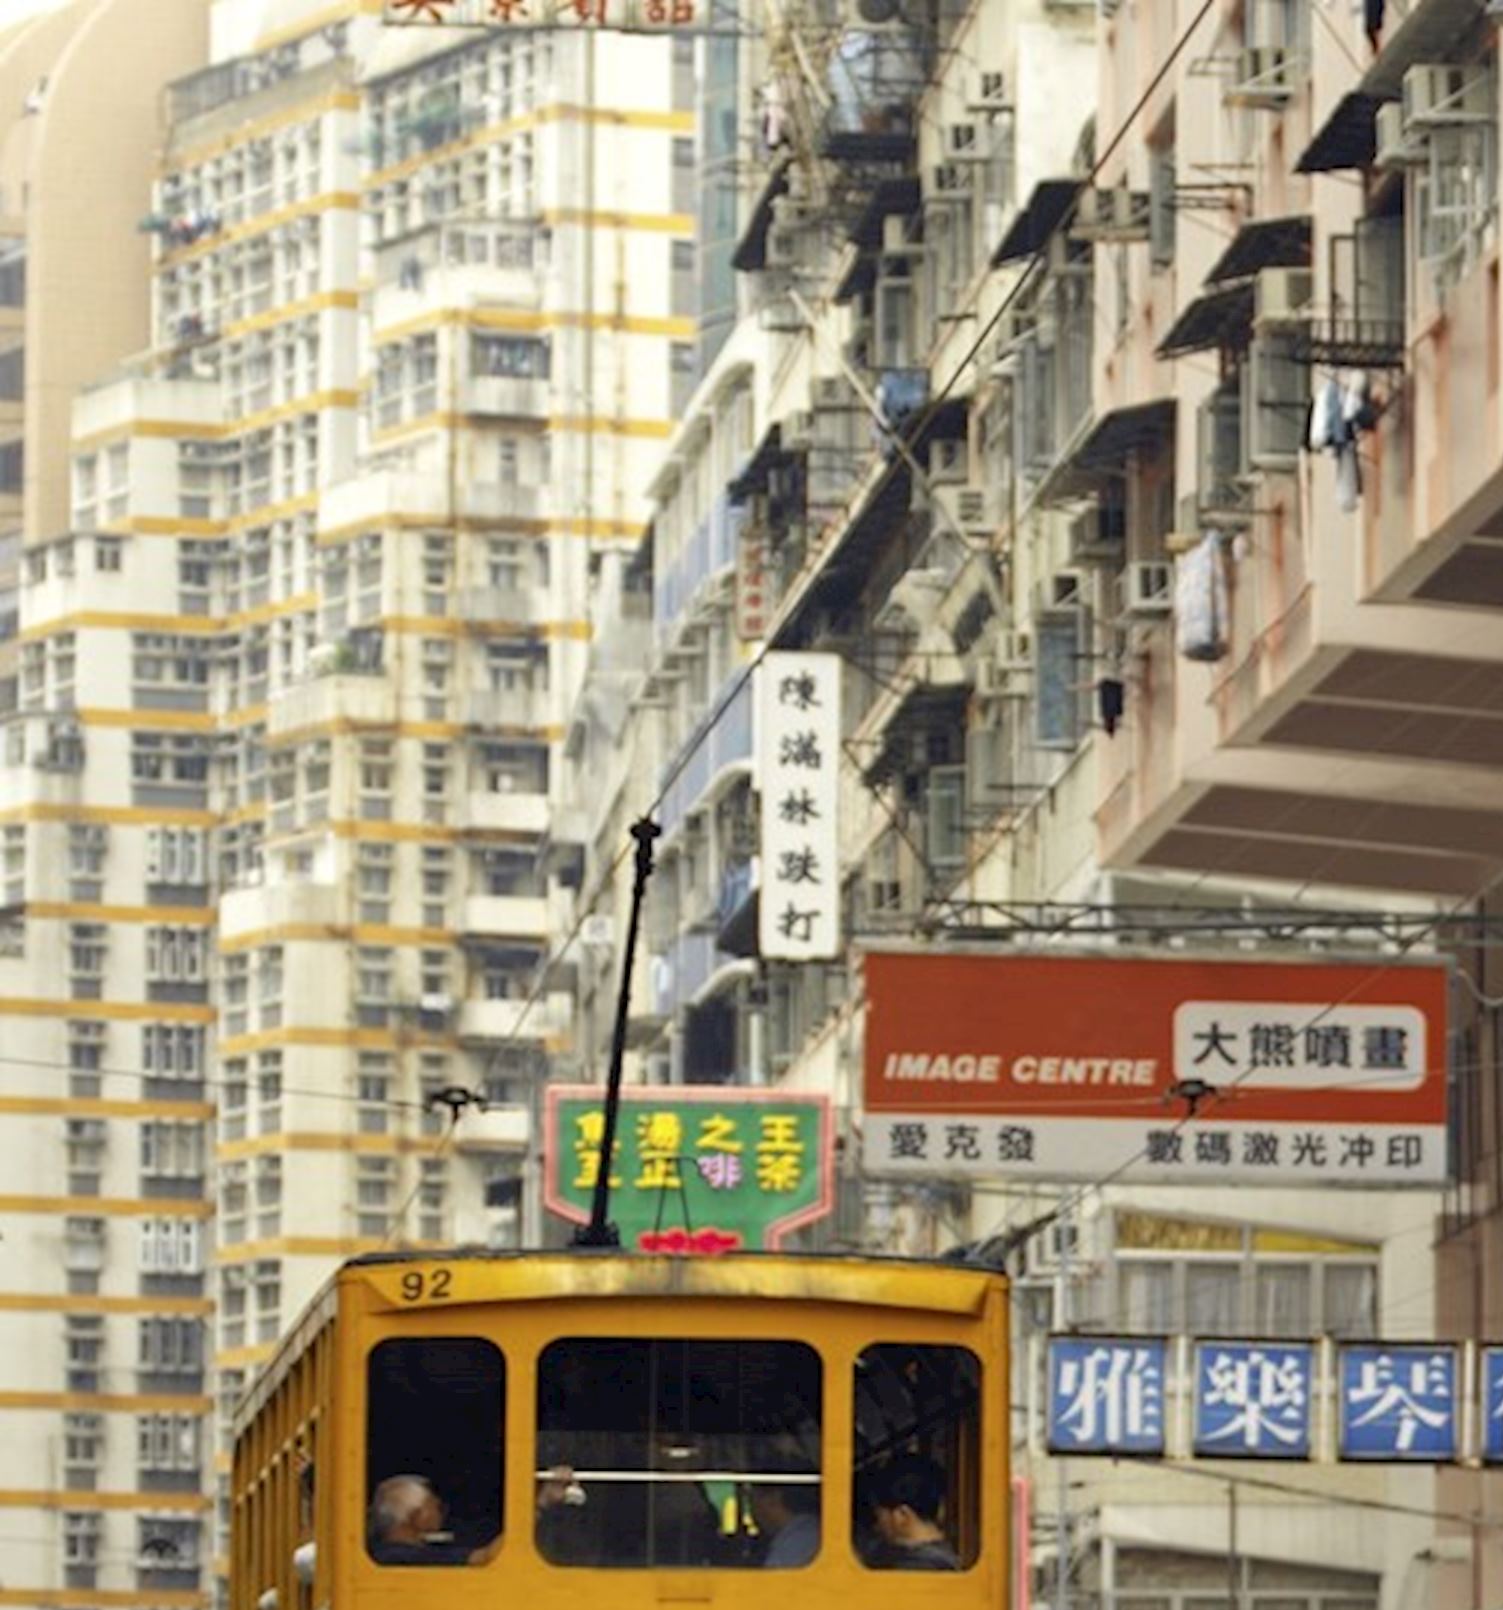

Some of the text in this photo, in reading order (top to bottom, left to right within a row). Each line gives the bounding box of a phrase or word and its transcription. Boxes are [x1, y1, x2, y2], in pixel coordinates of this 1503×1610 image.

[1192, 1021, 1410, 1070] 大熊噴畫
[884, 1053, 1159, 1086] IMAGE CENTRE
[888, 1122, 1036, 1163] 愛克發
[402, 1268, 452, 1302] 92
